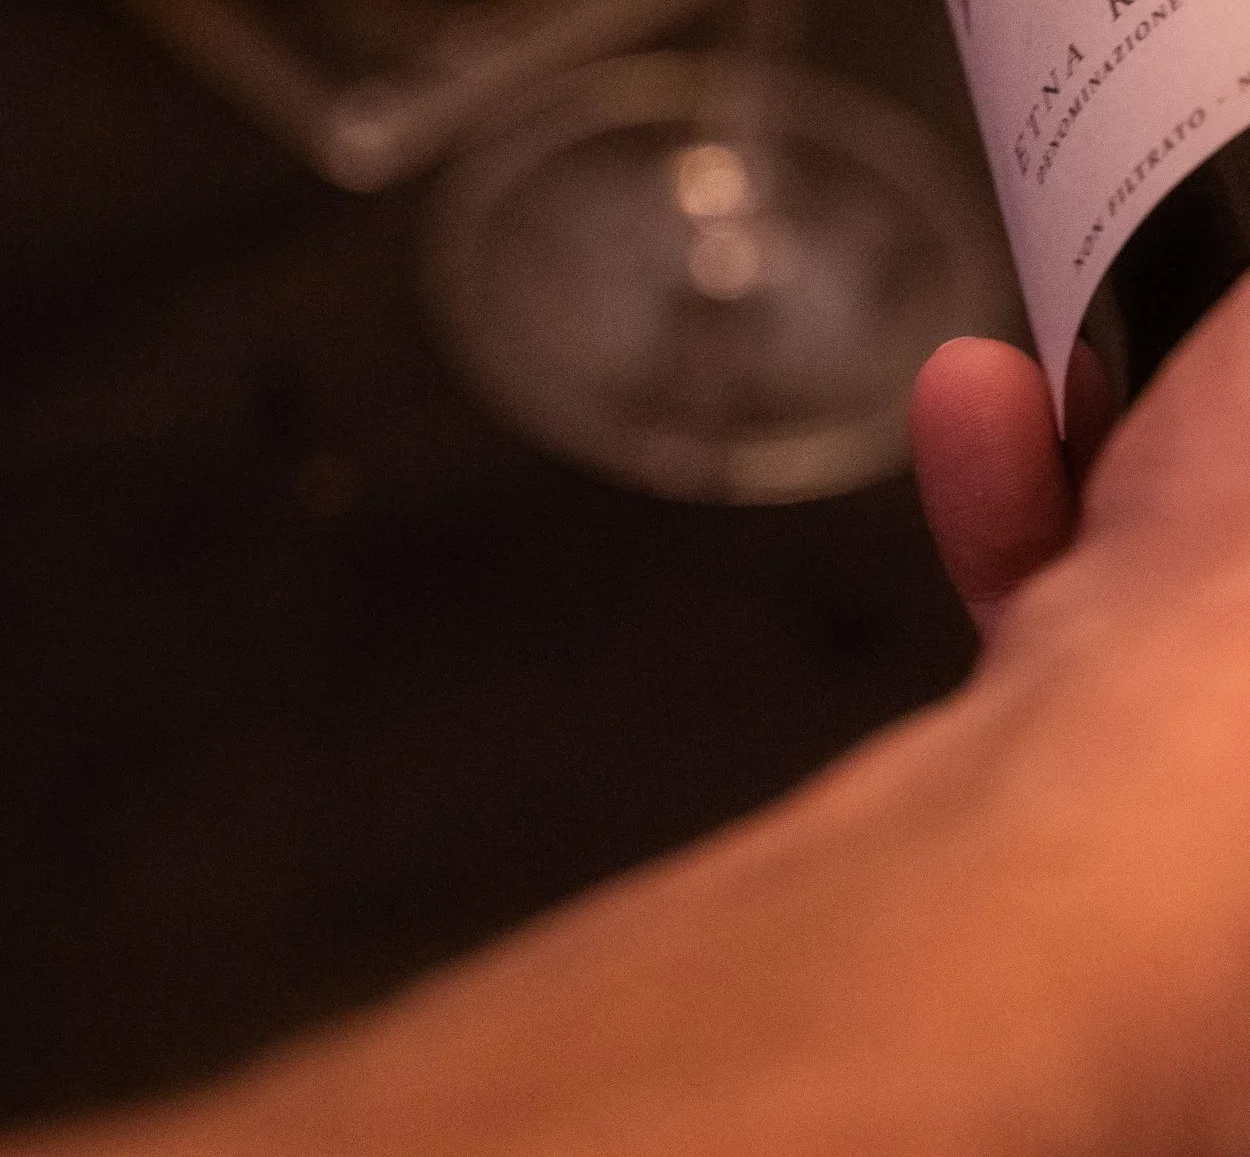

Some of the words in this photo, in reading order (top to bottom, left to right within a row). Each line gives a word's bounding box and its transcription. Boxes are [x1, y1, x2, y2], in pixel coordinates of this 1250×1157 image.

[1012, 41, 1087, 178] ETNA
[1070, 221, 1108, 271] NON
[1107, 105, 1208, 219] FILTRATO
